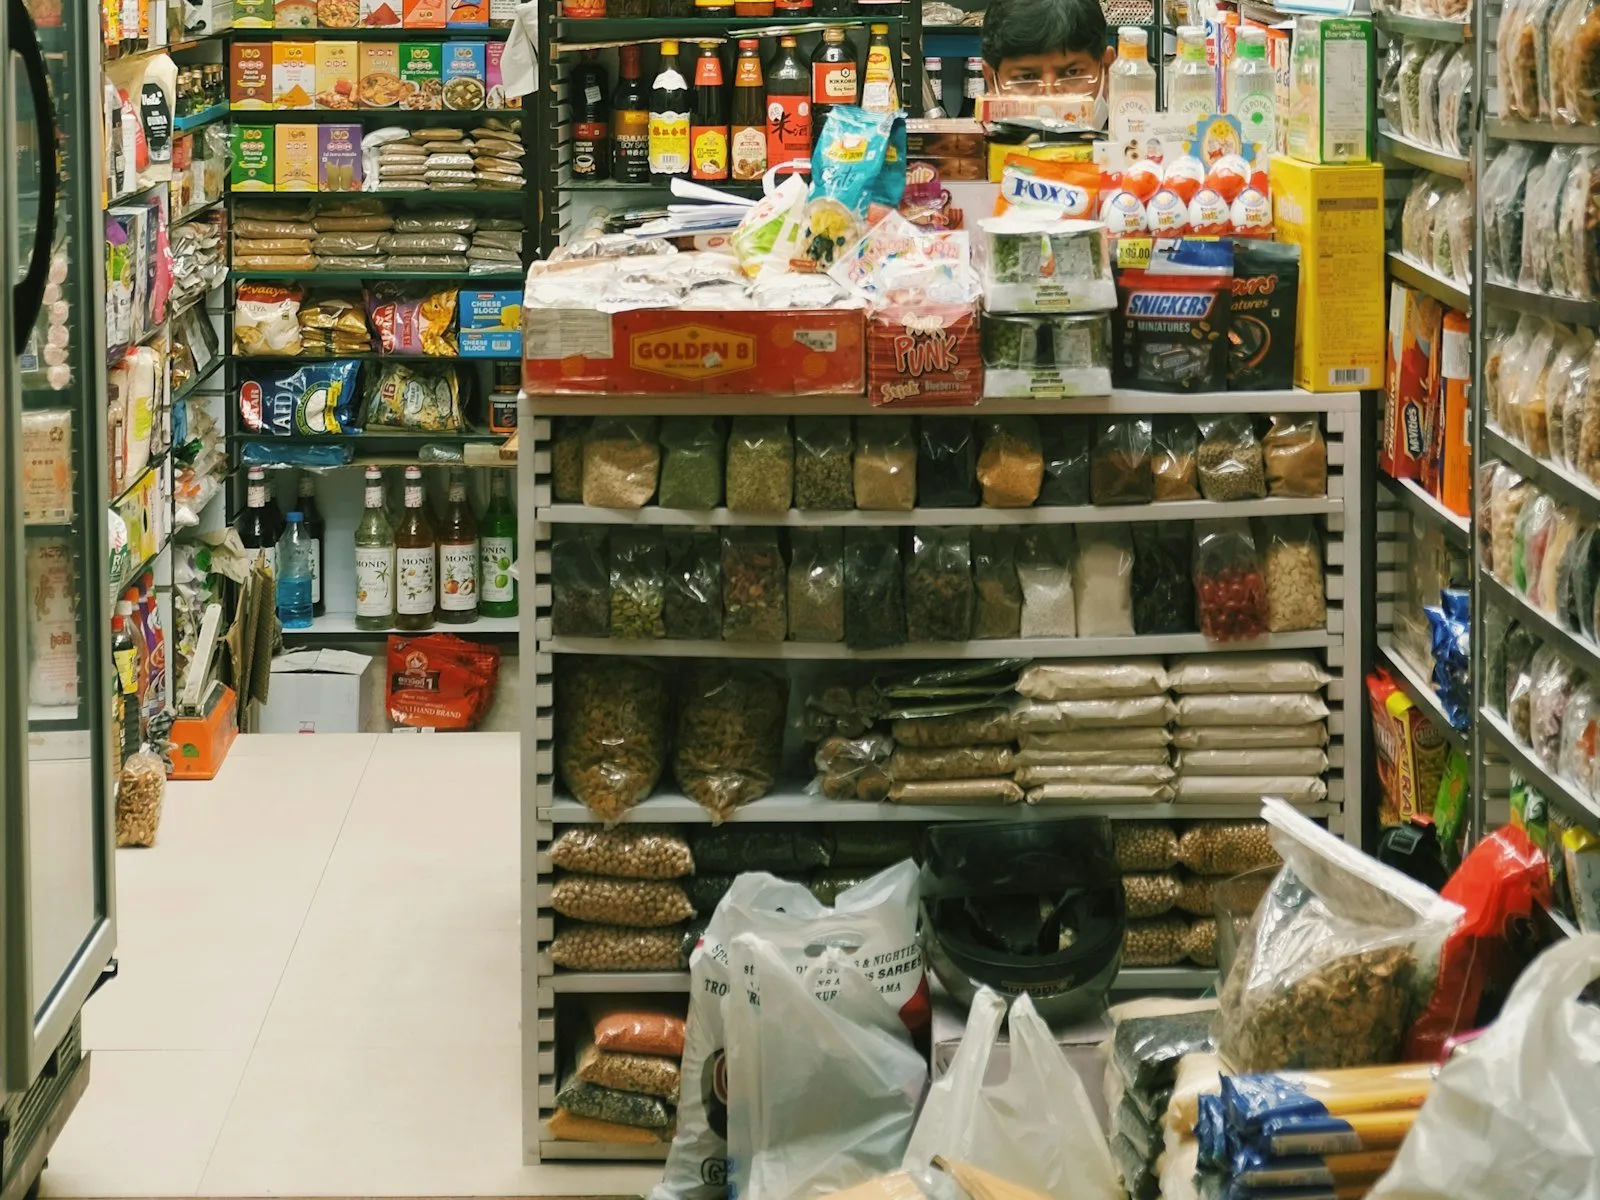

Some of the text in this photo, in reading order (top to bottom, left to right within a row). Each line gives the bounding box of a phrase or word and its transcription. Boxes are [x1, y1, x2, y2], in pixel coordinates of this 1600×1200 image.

[1012, 177, 1079, 208] FOX'S
[1232, 274, 1278, 296] ars
[1129, 294, 1212, 316] SNICKERS
[1231, 300, 1268, 310] atures
[1138, 322, 1190, 332] MINIATURES
[637, 342, 749, 361] GOLDEN 8
[894, 334, 958, 376] PUNK
[402, 557, 433, 565] MONIN
[446, 554, 476, 562] MONIN
[413, 706, 462, 718] HAND BRAND
[872, 944, 920, 964] NIGHTIE
